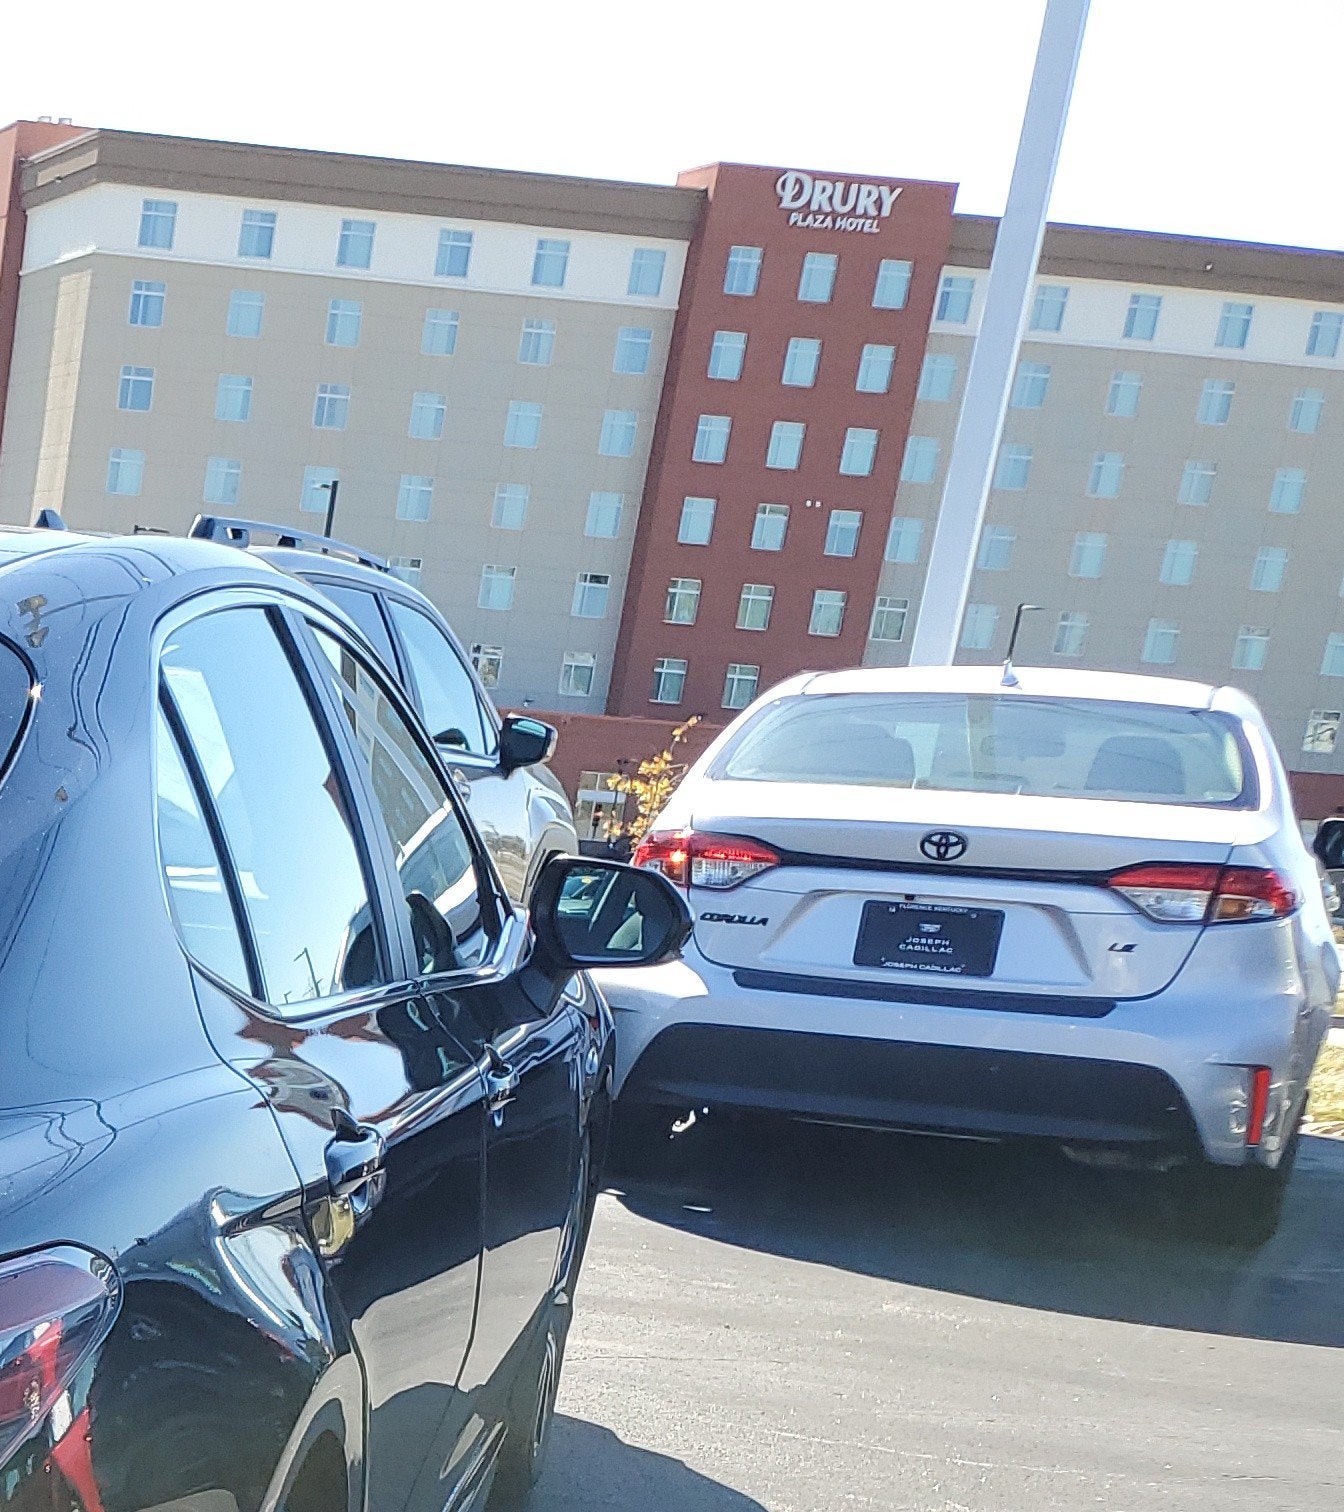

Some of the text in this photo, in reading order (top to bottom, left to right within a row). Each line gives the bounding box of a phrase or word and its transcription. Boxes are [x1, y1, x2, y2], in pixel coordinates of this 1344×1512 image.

[776, 170, 903, 218] DRURY
[789, 212, 881, 233] PLAZA HOTEL
[905, 937, 951, 946] JOSEPH
[898, 944, 954, 954] CADILLAC
[882, 961, 963, 973] JOSEPH CADILLAC
